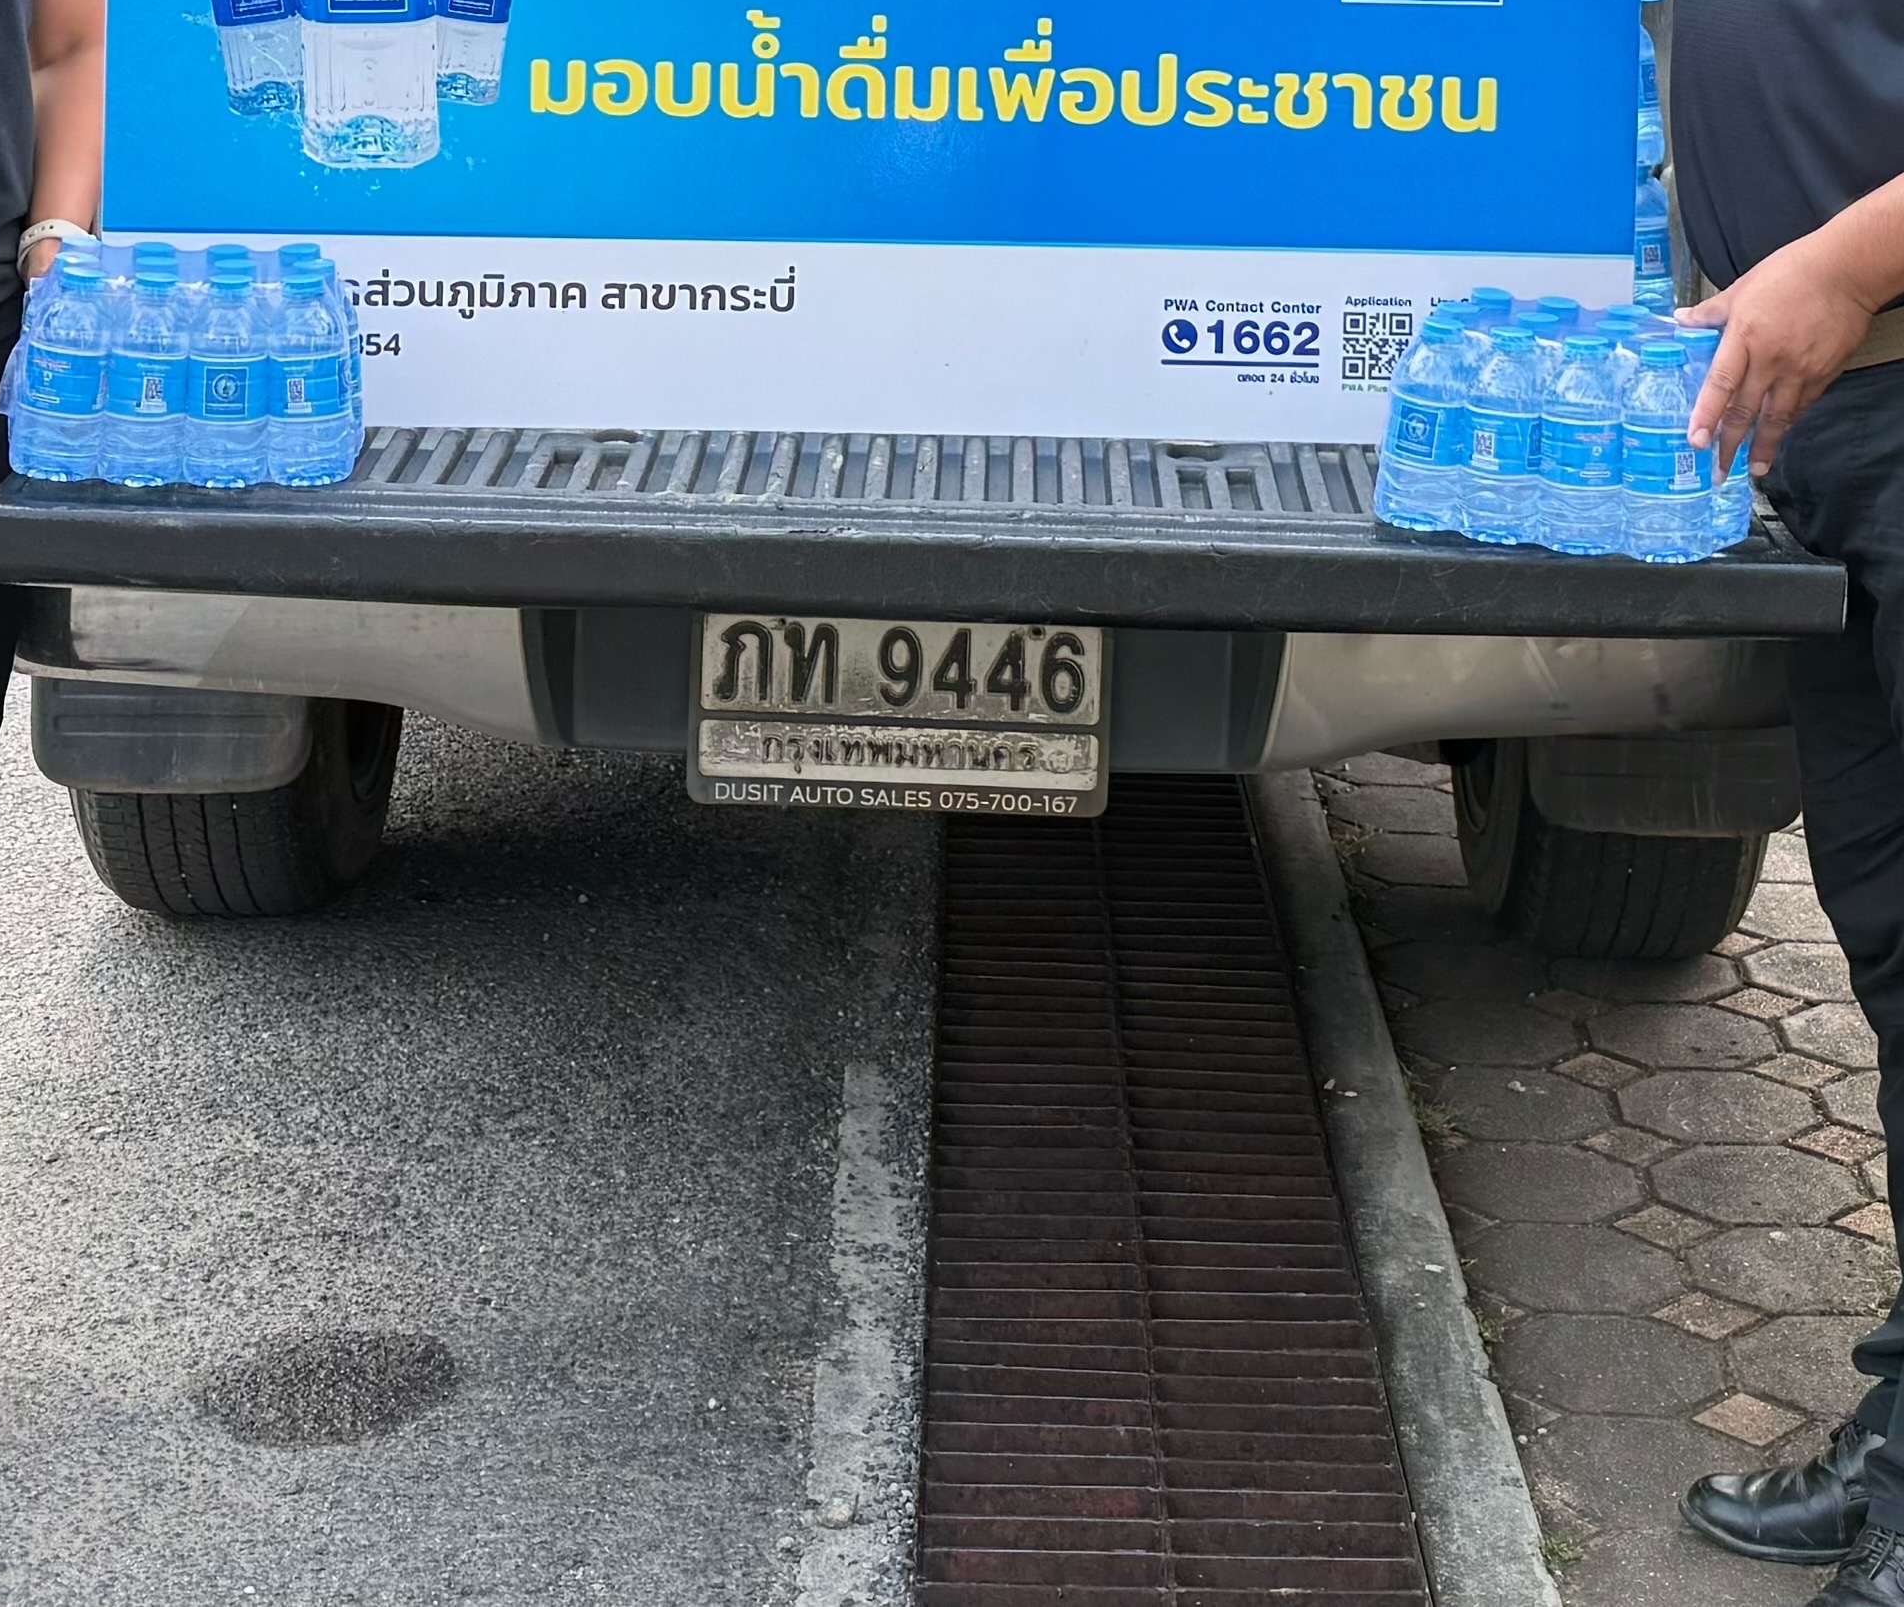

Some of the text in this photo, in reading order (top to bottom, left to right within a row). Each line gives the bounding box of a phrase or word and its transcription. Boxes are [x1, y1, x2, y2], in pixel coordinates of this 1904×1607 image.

[529, 9, 1498, 133] มอบน้ำดื่มเพื่อประชาชน
[600, 265, 796, 313] สาขากระบี่
[1163, 298, 1322, 315] PWA Contact Center
[1345, 295, 1413, 309] Application
[1206, 318, 1321, 357] 1662
[1237, 370, 1320, 384] ตลอด 24 ชั่วโมง
[1341, 383, 1364, 392] PWA
[713, 619, 1086, 714] ภท 9446
[761, 734, 1038, 774] กรุงเทพมหานคร
[714, 782, 1079, 814] DUSIT AUTO SALES 075-700-167
